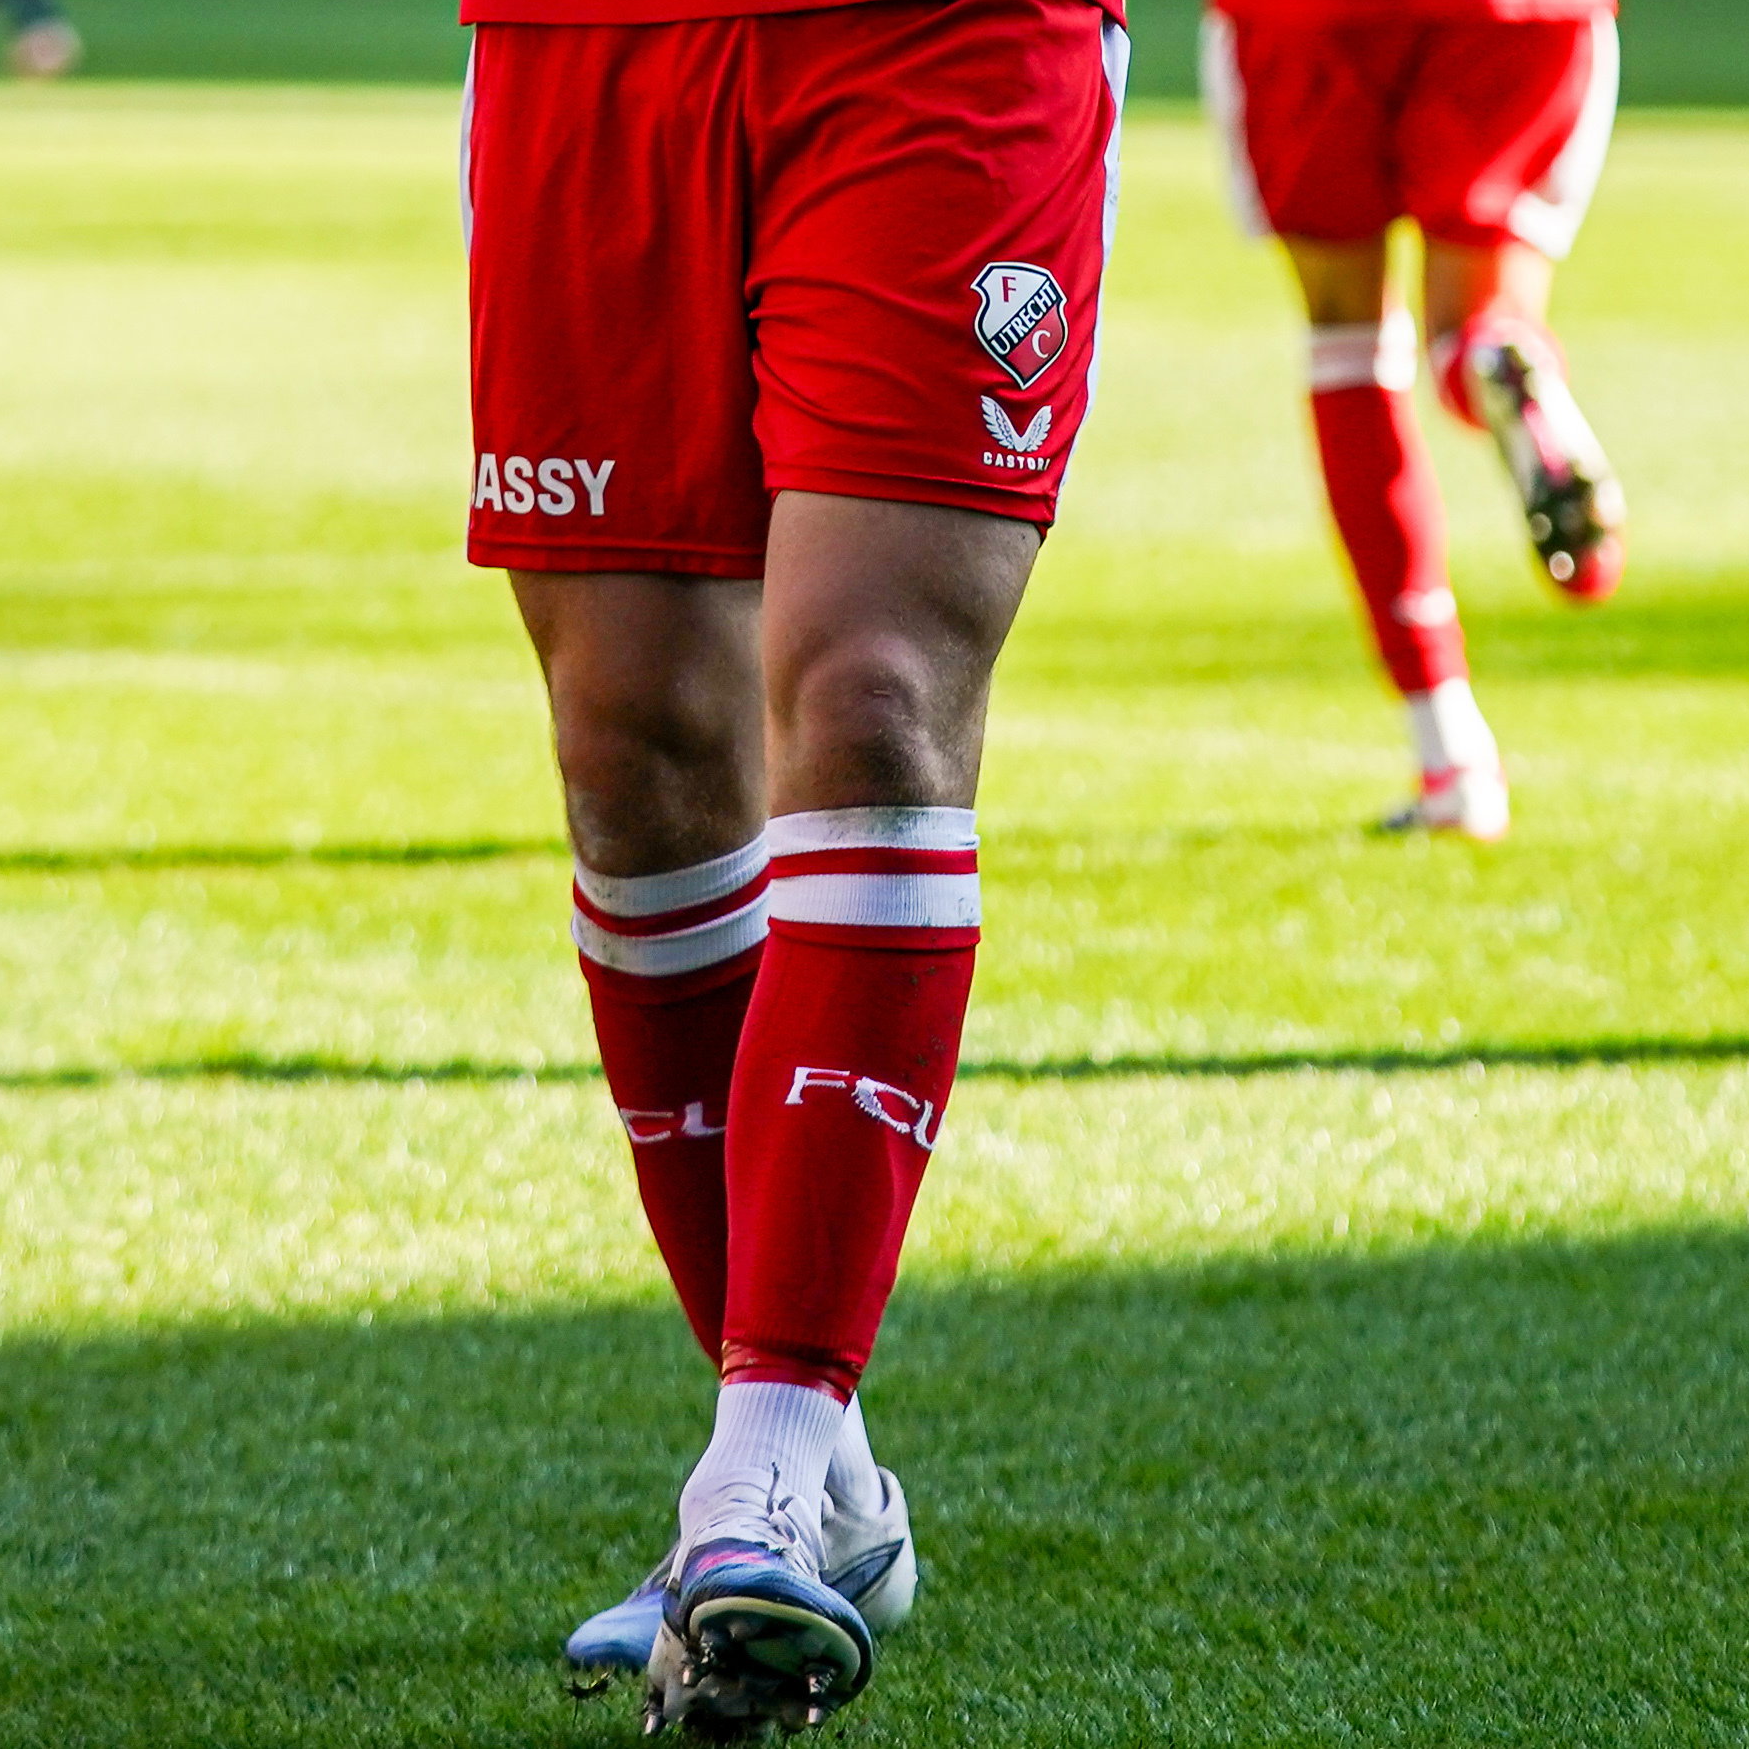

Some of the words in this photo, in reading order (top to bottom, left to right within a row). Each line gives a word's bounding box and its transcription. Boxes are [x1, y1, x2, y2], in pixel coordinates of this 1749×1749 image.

[1002, 276, 1017, 303] F
[991, 281, 1057, 356] UTRECHT
[1031, 329, 1051, 359] C
[472, 452, 616, 516] ASSY
